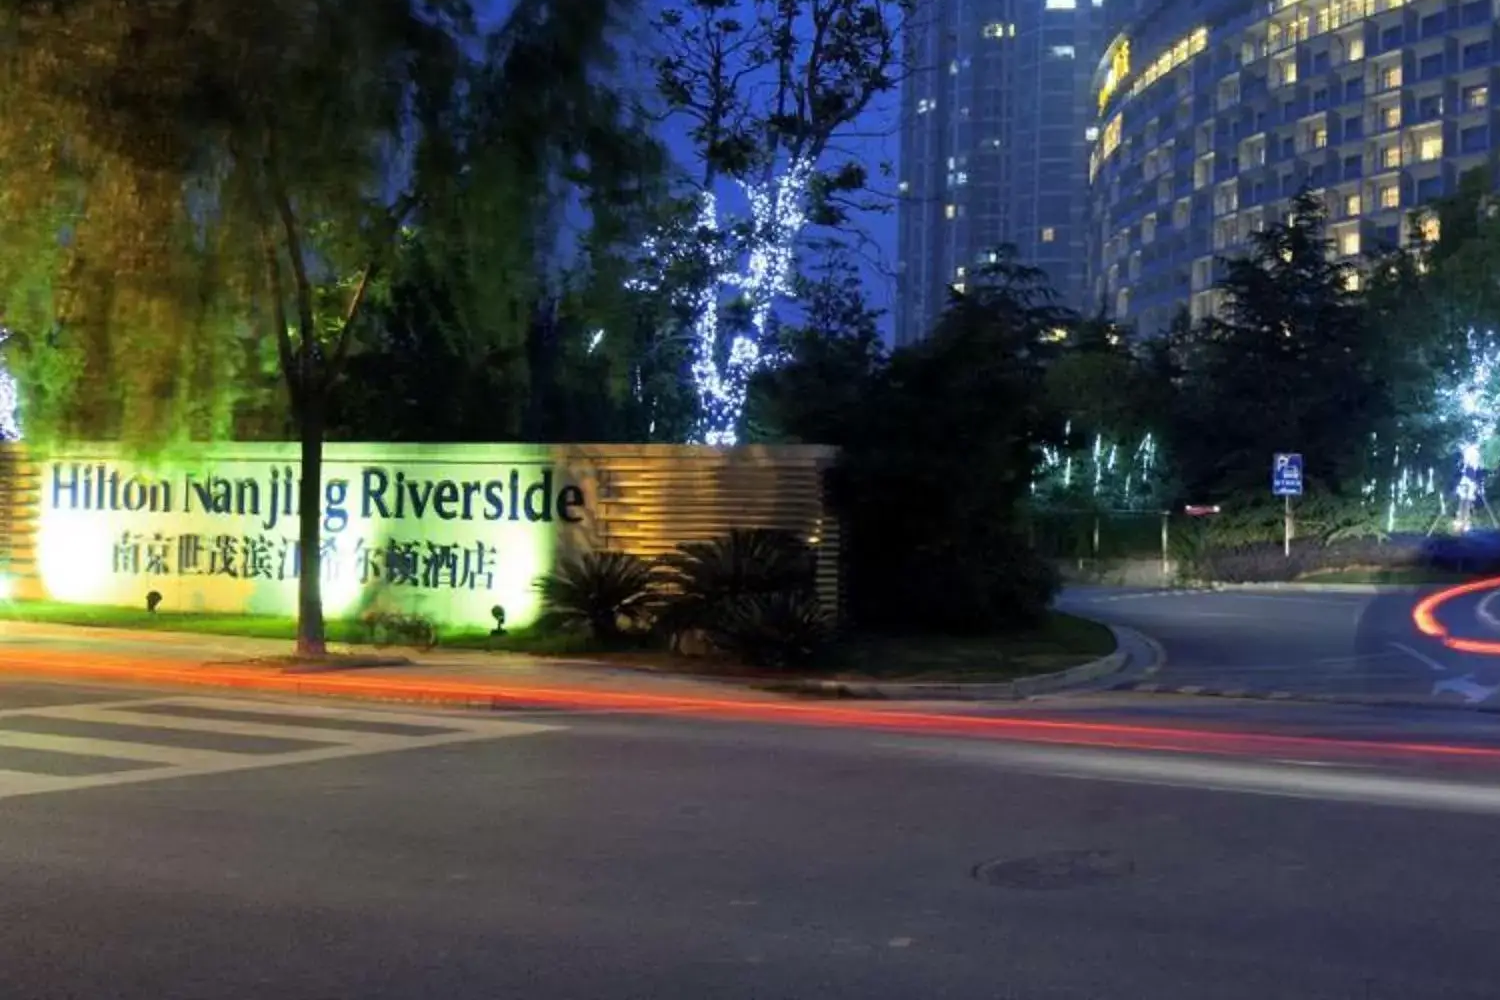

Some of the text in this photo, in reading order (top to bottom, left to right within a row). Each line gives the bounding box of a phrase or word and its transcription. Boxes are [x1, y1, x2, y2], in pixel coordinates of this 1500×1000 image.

[51, 463, 585, 532] Hilton Nanjig Riverside
